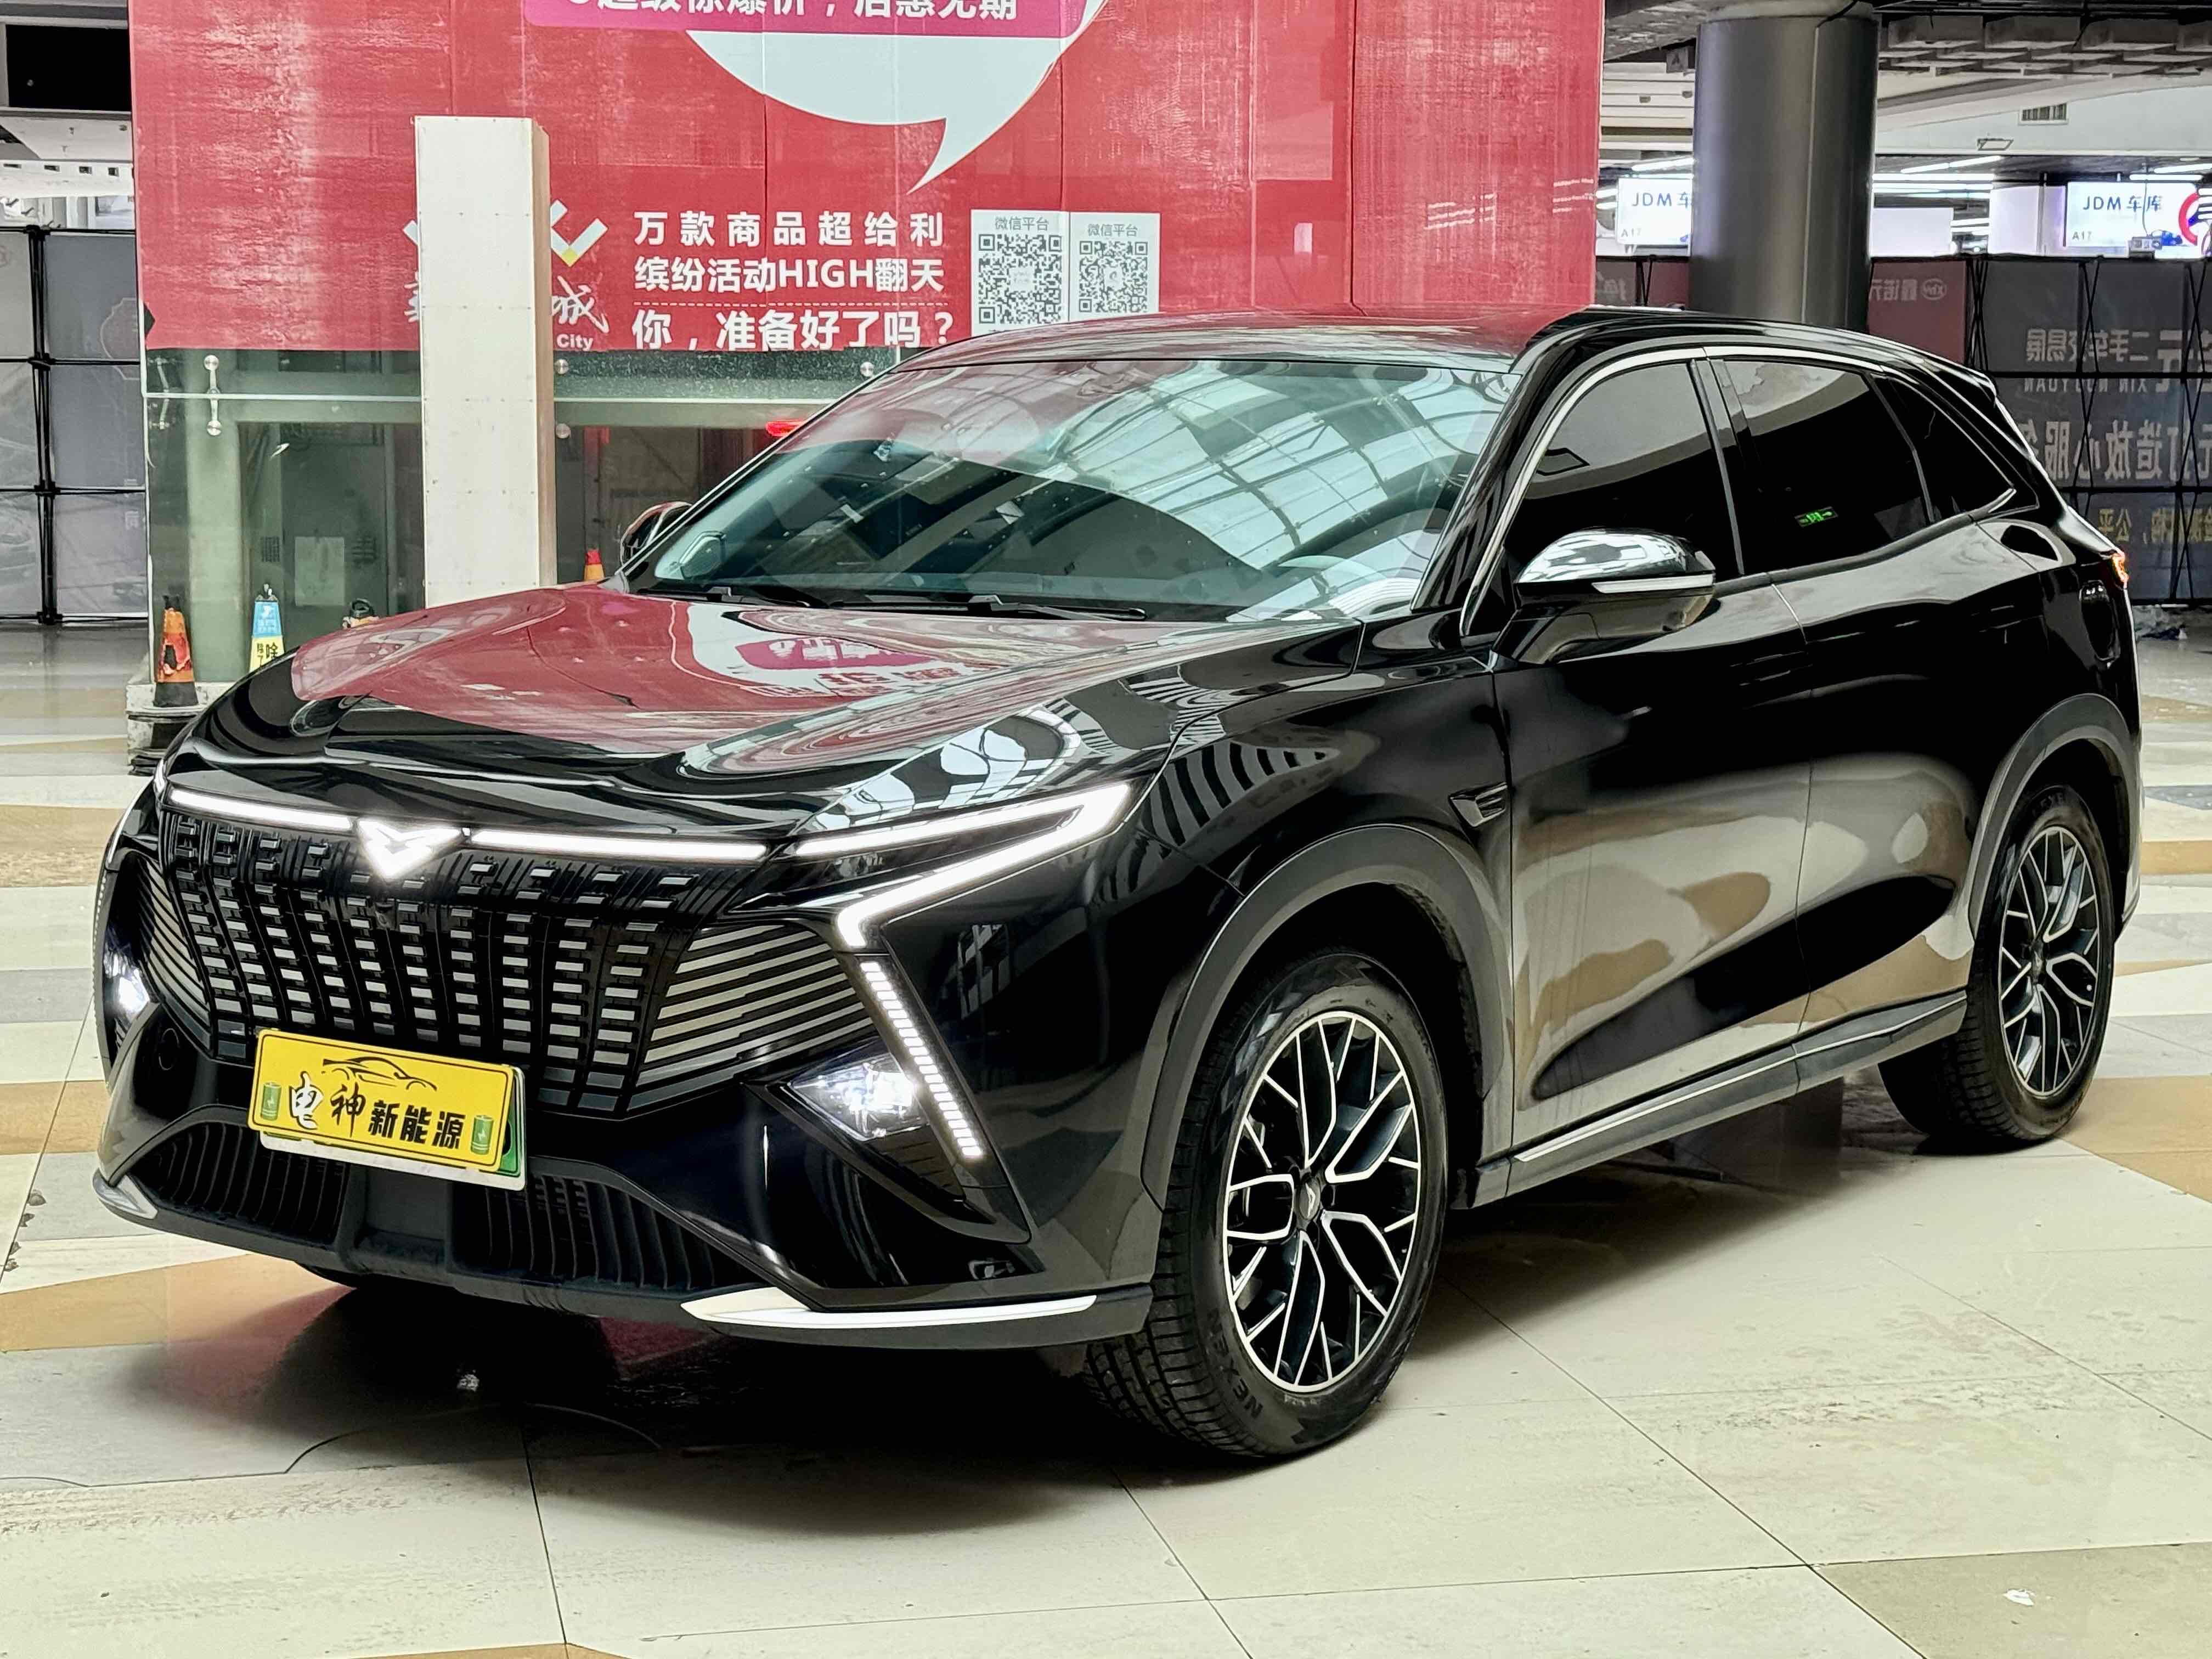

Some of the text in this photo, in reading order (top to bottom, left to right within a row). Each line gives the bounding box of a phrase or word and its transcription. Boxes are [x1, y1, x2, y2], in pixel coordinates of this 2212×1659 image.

[1632, 193, 1672, 207] JDM
[2083, 195, 2162, 212] JDM 车库
[634, 211, 943, 246] 万款商品超给利
[995, 217, 1049, 232] 微信平台
[1088, 223, 1138, 237] 微信平台
[2072, 231, 2092, 240] A17
[634, 256, 944, 293] 缤纷活动HIGH翻天
[557, 334, 594, 351] City
[289, 1070, 466, 1150] 电神新能源
